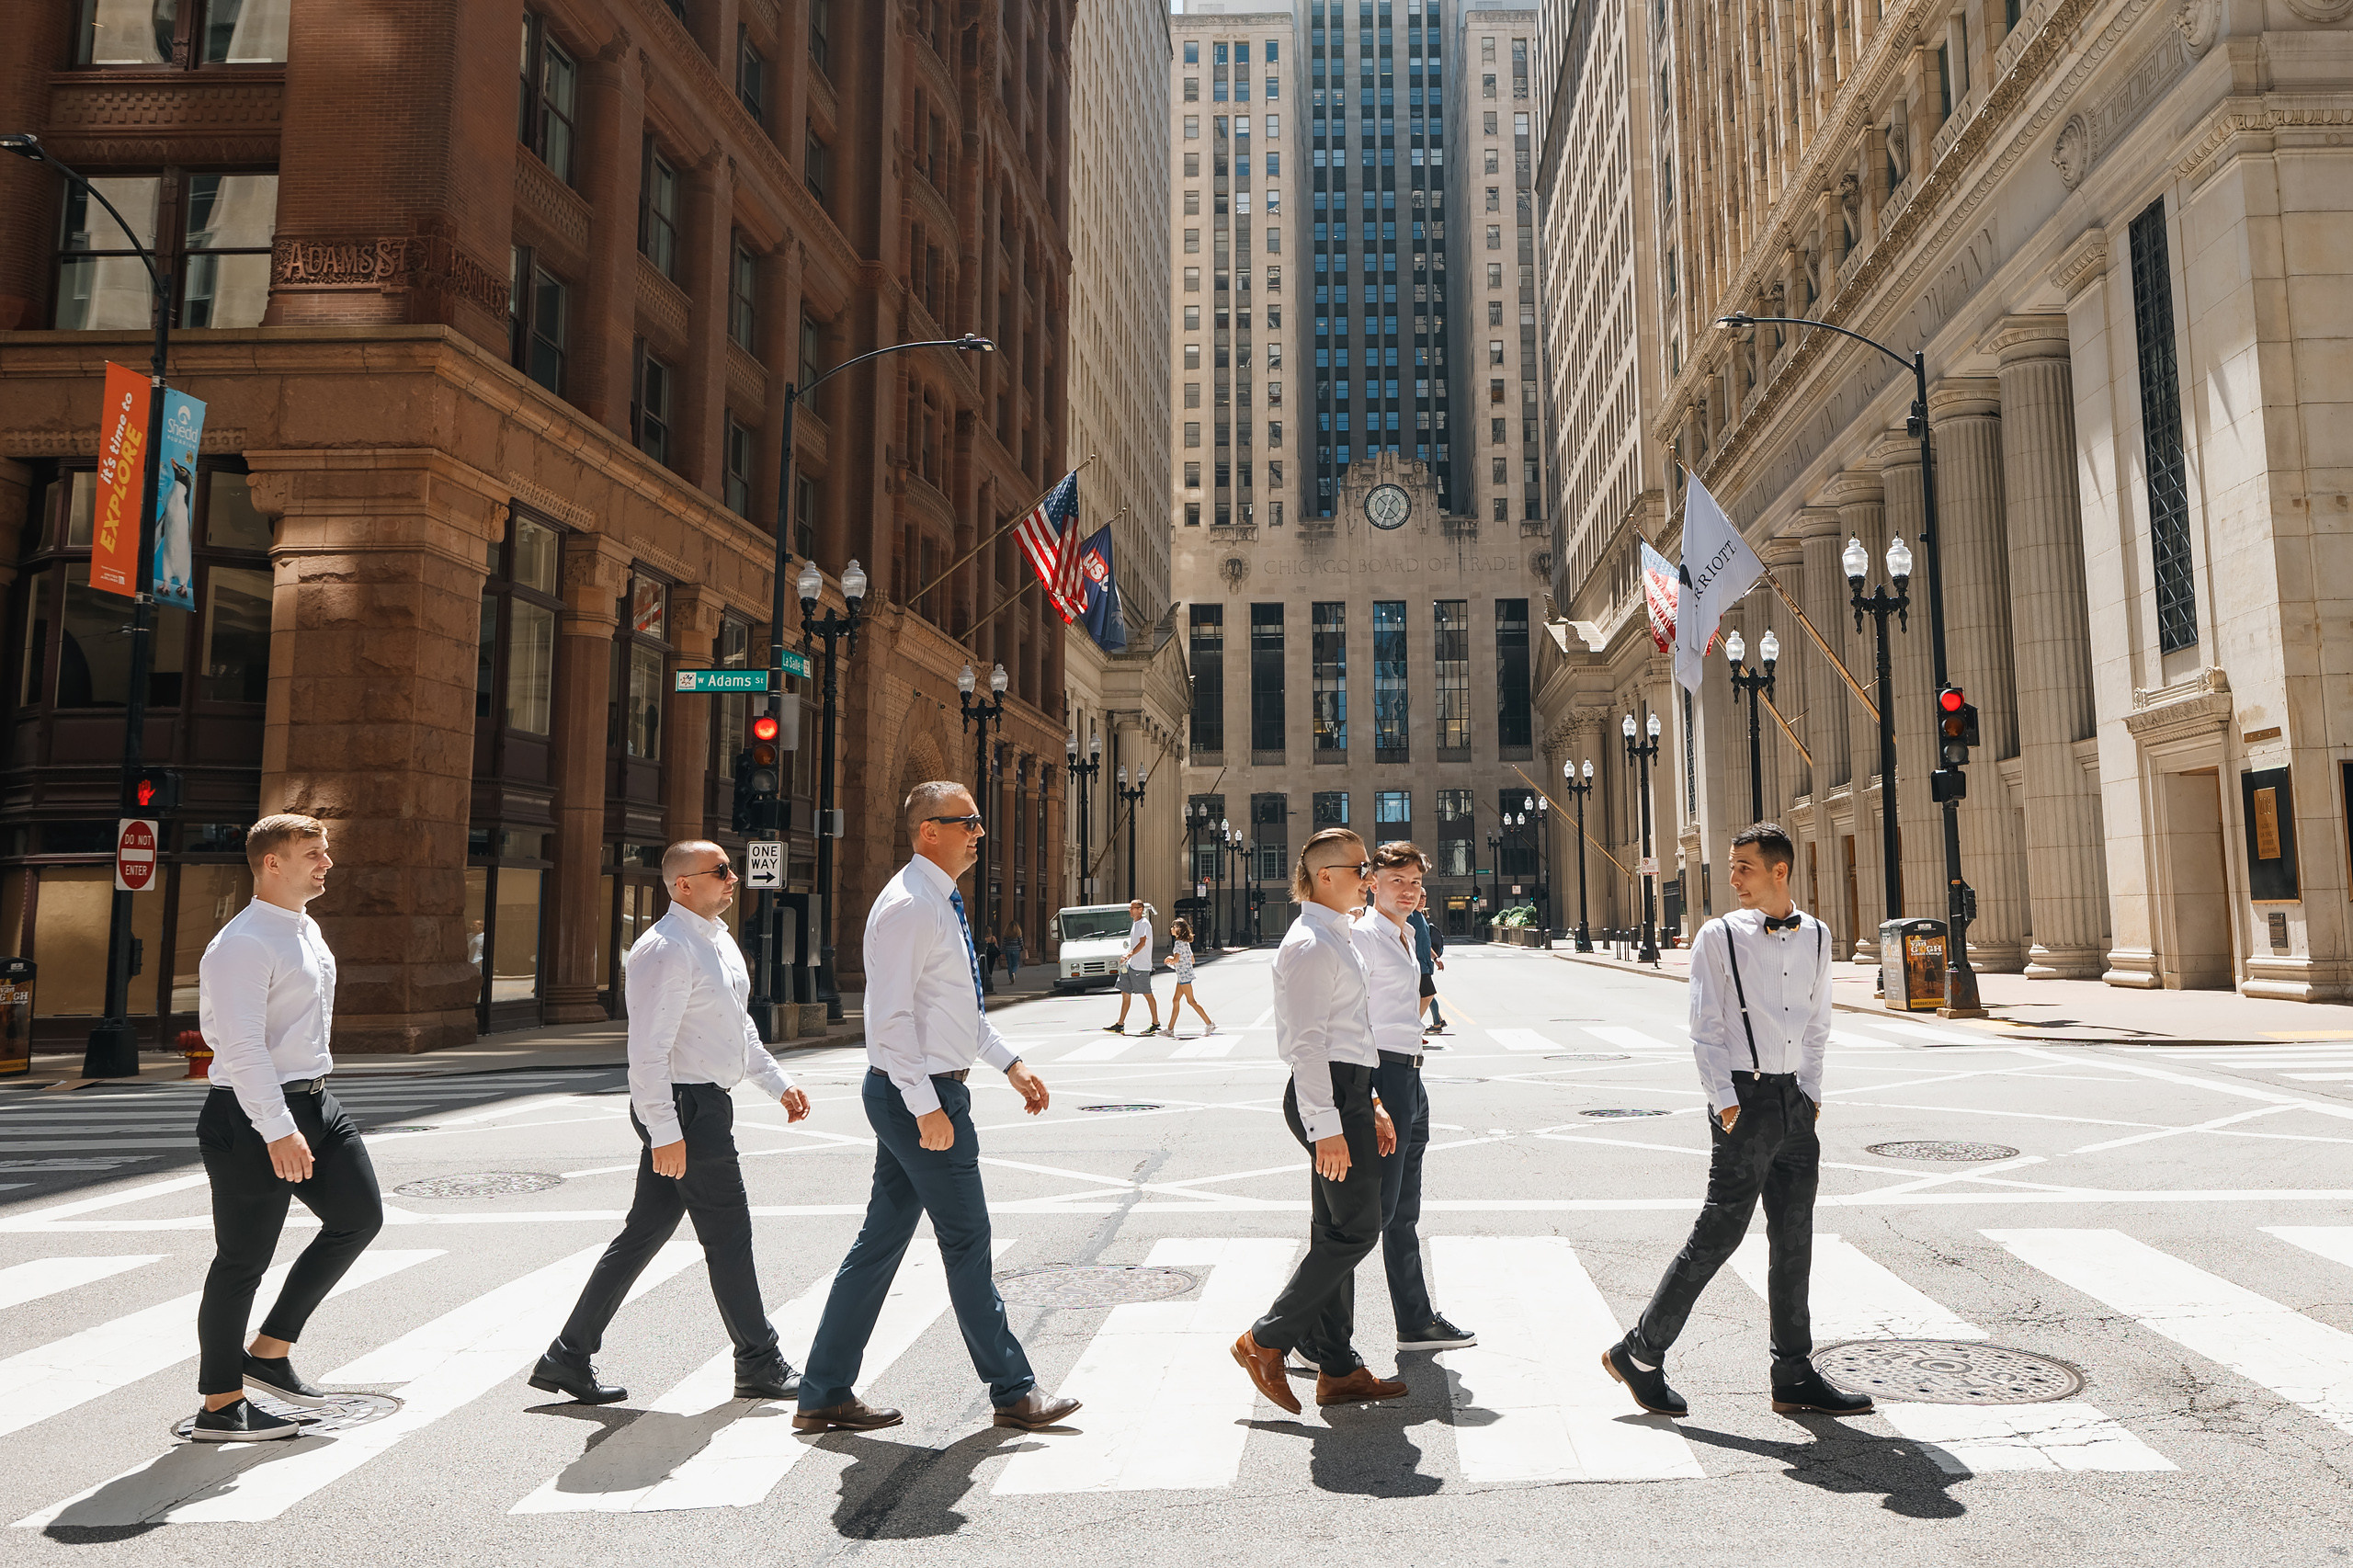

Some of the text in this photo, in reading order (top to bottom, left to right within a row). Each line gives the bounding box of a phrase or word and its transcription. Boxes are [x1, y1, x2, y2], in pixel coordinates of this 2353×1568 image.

[285, 237, 407, 278] ADAMS ST
[1905, 217, 1996, 353] COMPANY
[100, 392, 132, 484] it's time to
[167, 418, 199, 443] Shedd
[99, 422, 142, 554] EXPLORE
[1264, 556, 1517, 574] CHICAGO BOARD OF TRADE
[1694, 540, 1737, 600] RRIOTT
[782, 653, 789, 667] La
[707, 674, 752, 687] Adams
[2258, 796, 2271, 815] 208
[125, 834, 152, 846] DO NOT
[752, 846, 778, 857] ONE
[125, 865, 147, 876] ENTER
[751, 858, 778, 869] WAY
